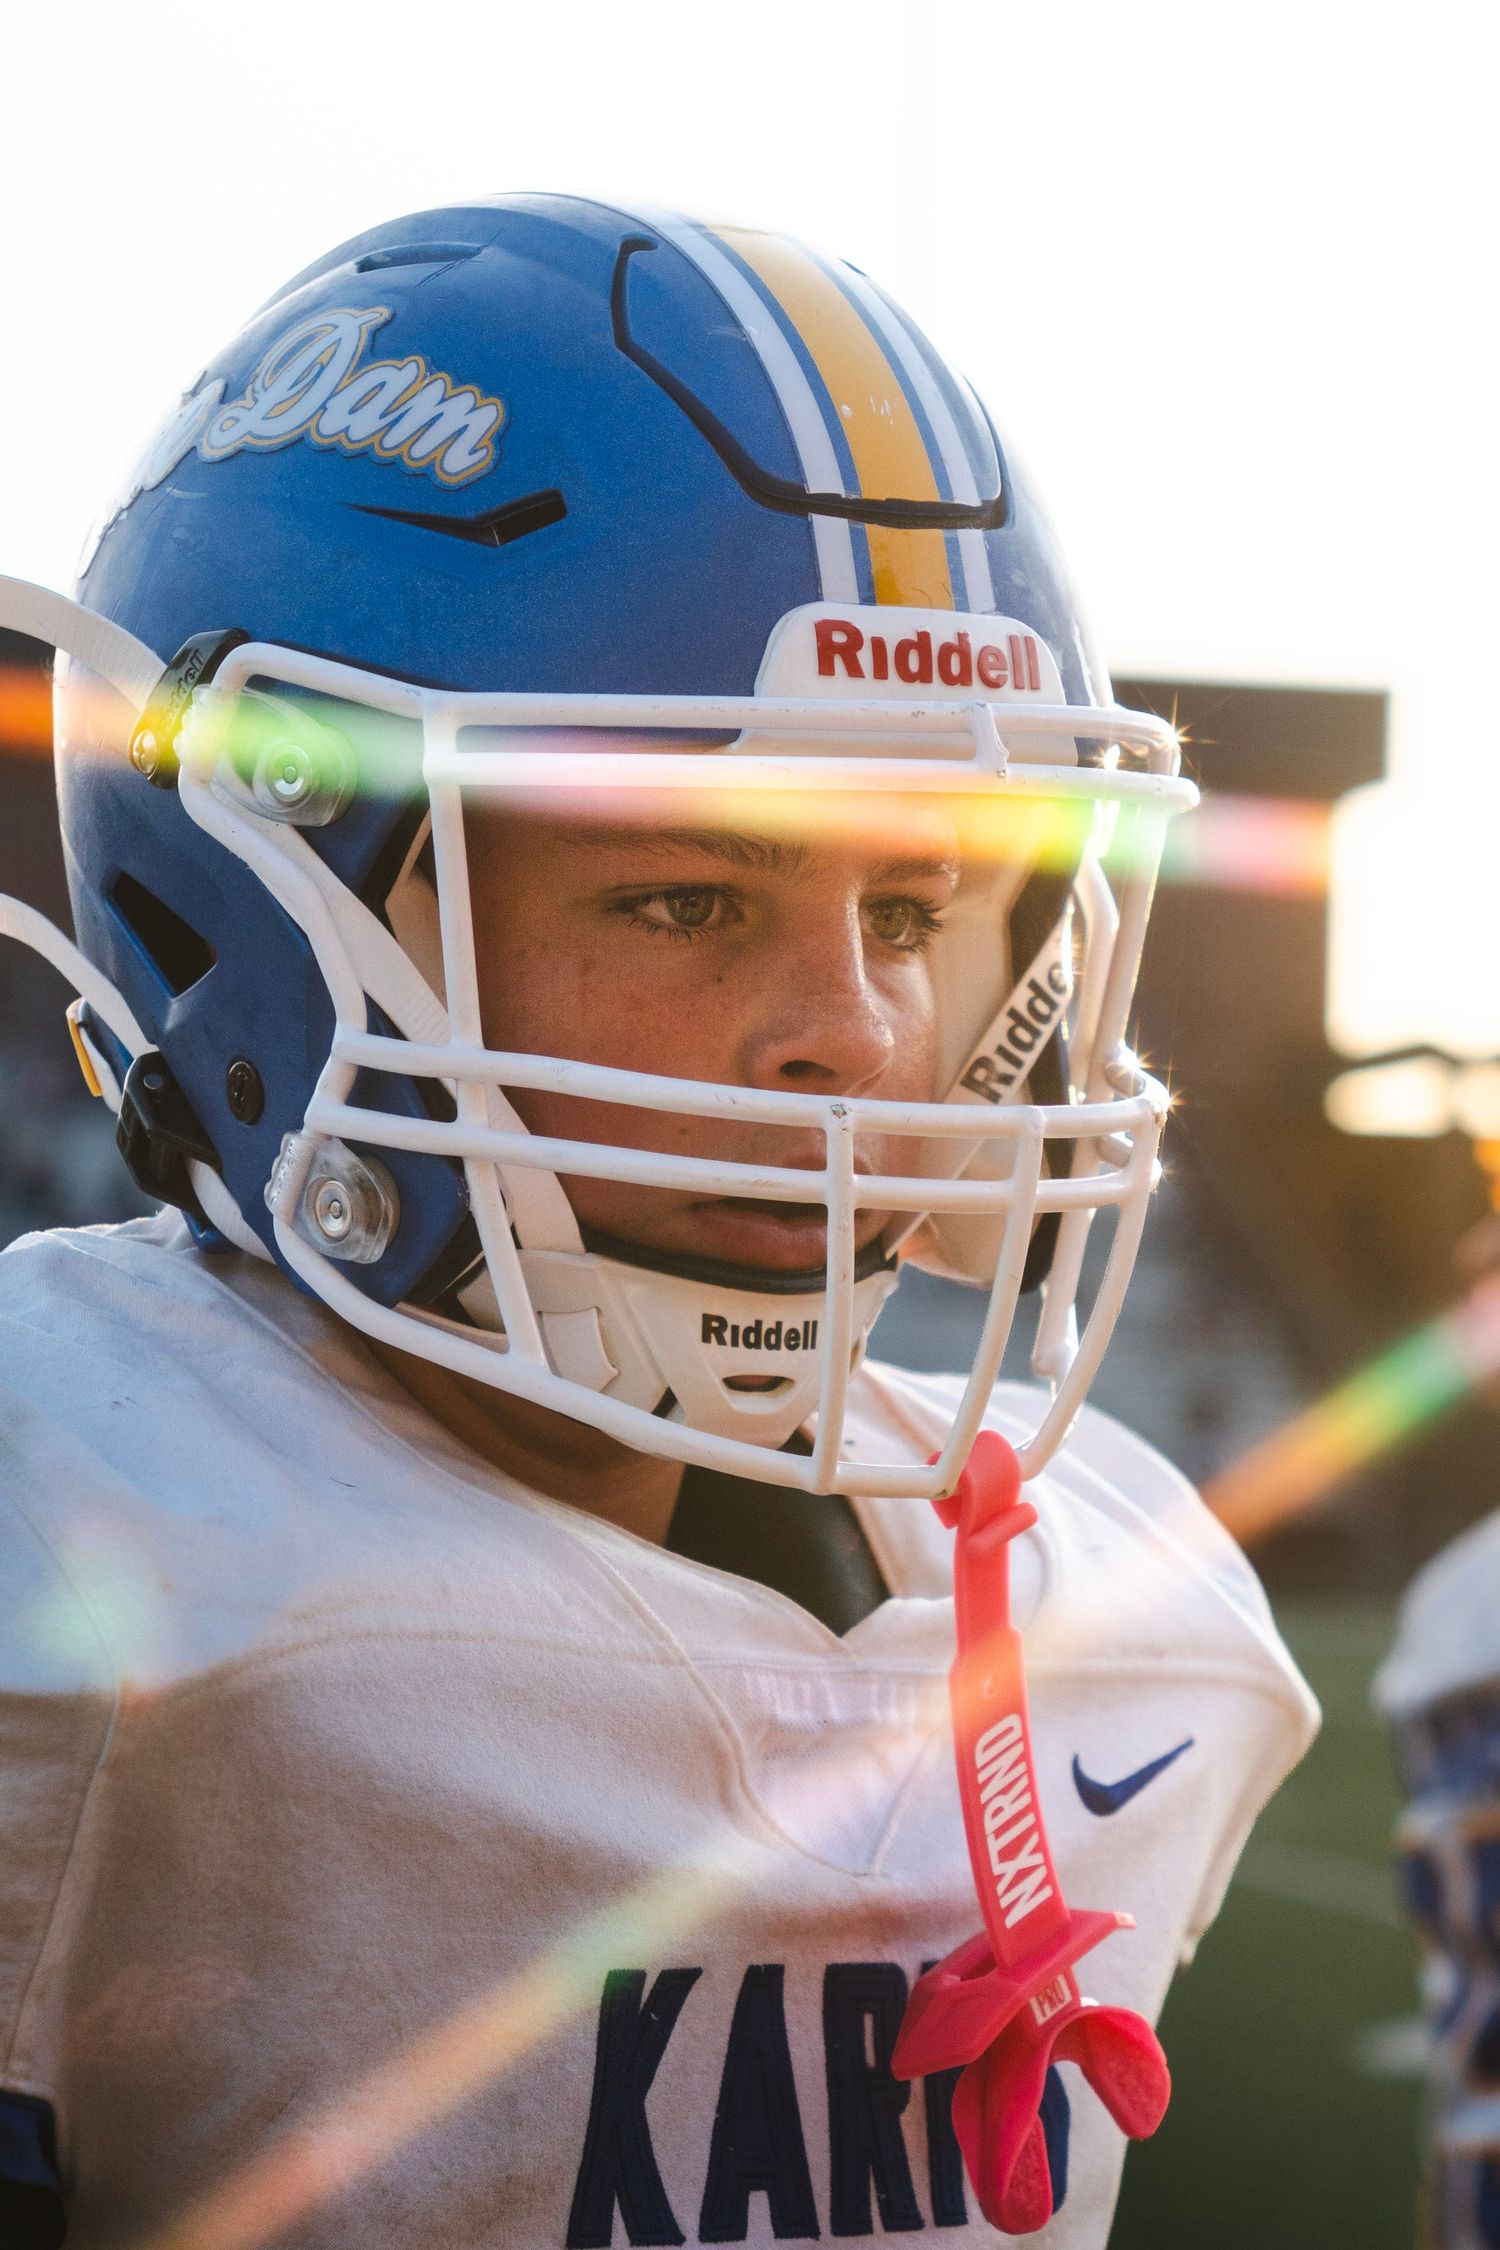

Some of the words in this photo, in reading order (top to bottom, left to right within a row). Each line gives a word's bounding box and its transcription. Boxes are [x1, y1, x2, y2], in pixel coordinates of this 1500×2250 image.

[203, 307, 505, 484] Dam
[814, 619, 1041, 690] Riddell
[701, 1313, 818, 1351] Riddell
[974, 1713, 1053, 1929] NXTRND
